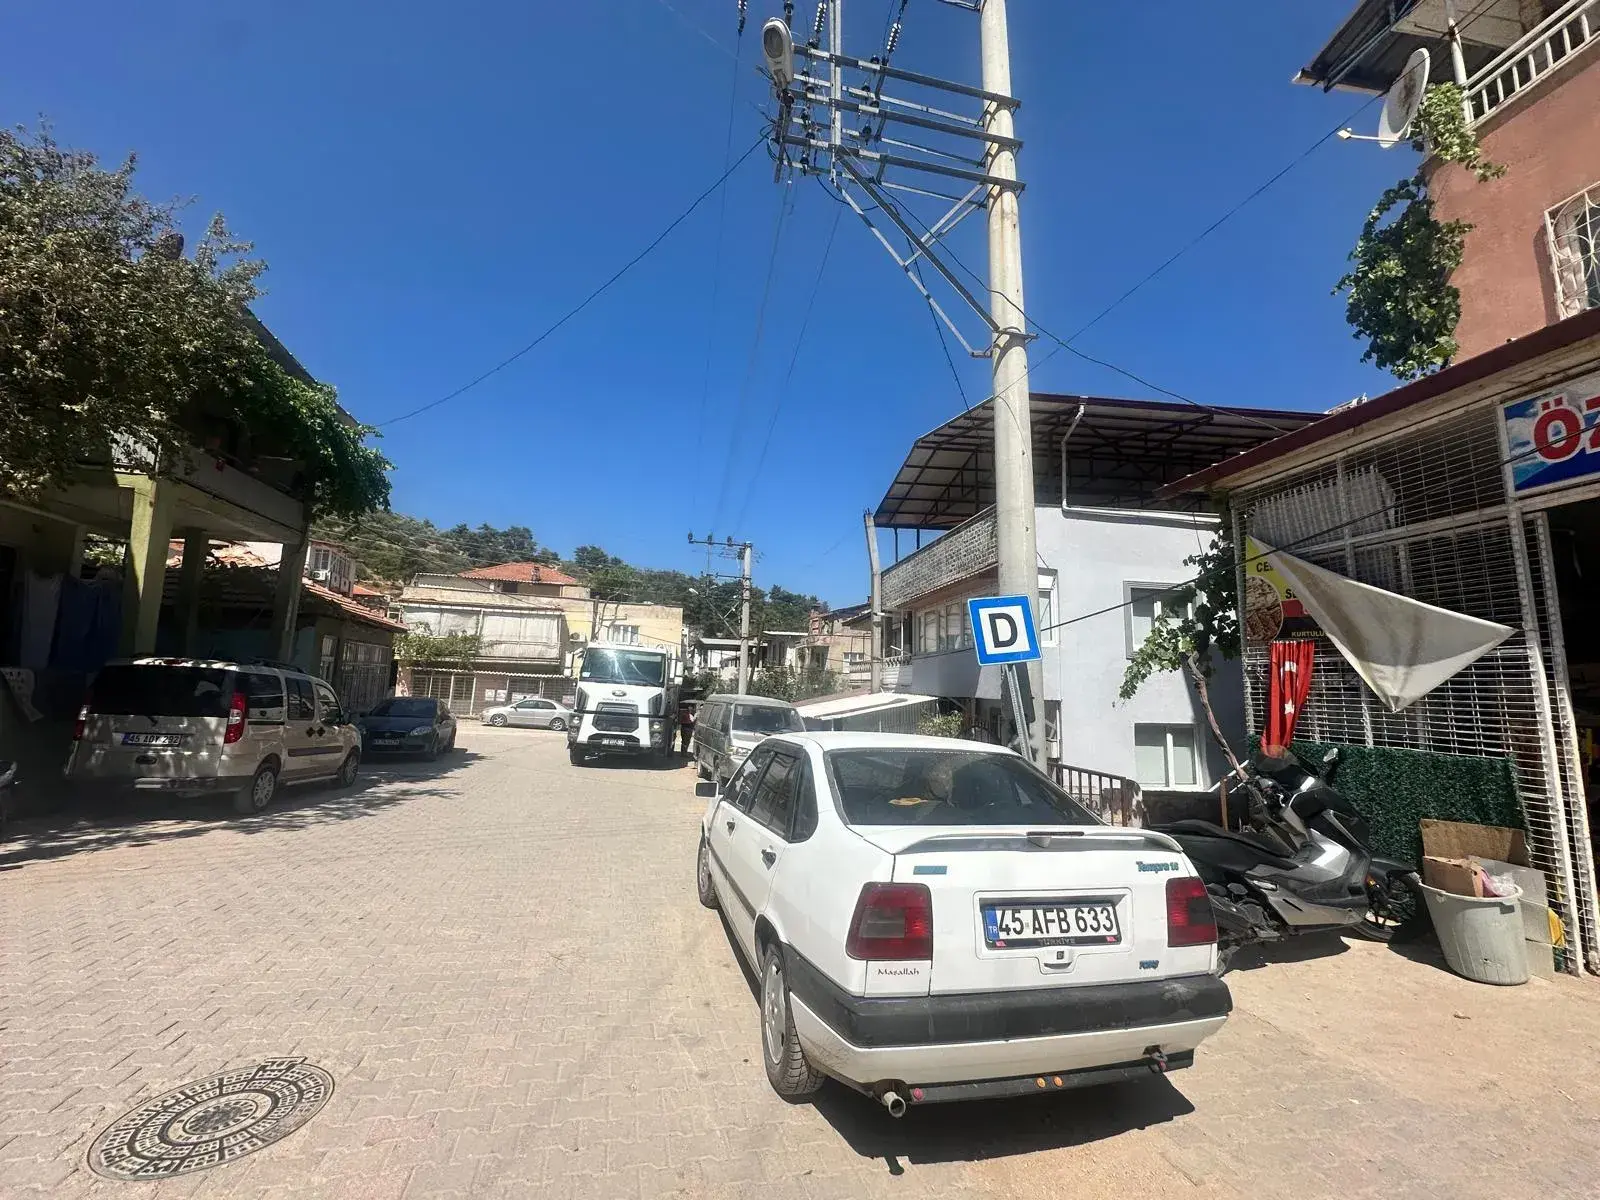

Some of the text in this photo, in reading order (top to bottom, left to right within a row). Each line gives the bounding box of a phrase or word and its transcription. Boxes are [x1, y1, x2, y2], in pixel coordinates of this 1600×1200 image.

[1256, 561, 1274, 573] CE
[988, 612, 1018, 648] D
[129, 734, 140, 743] 45
[162, 735, 178, 744] 292
[999, 906, 1114, 935] 45 AFB 633
